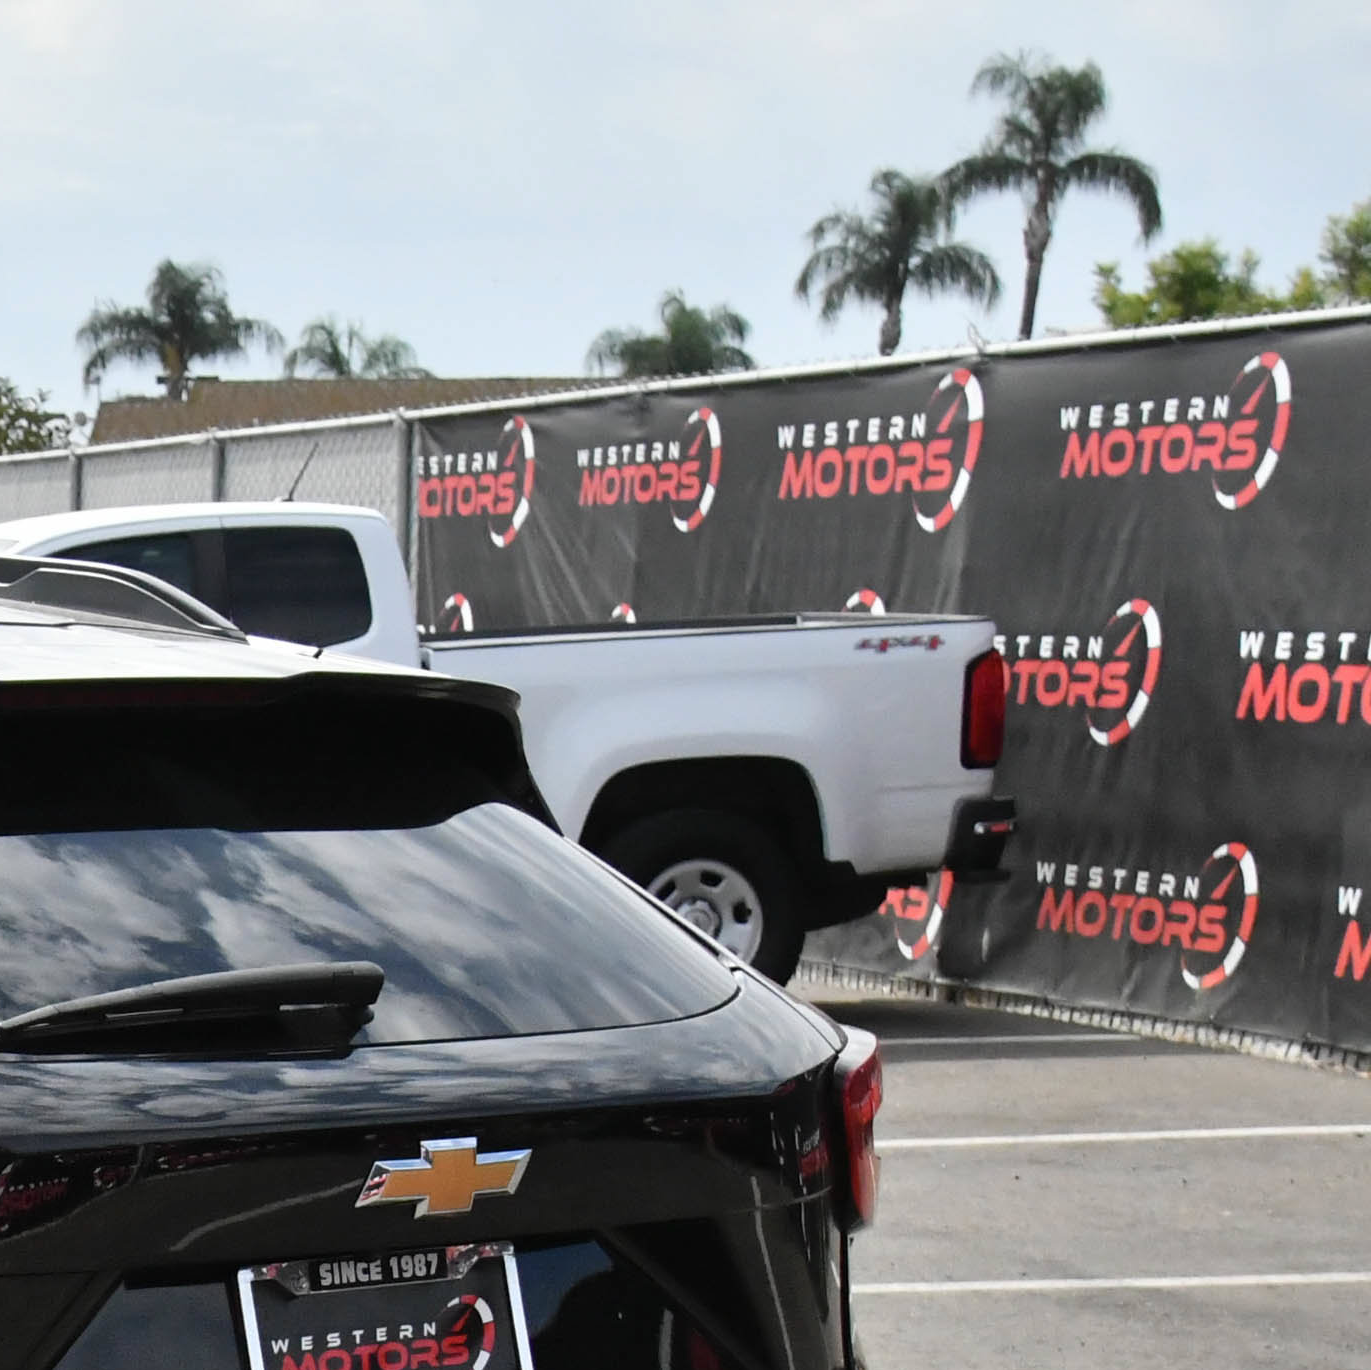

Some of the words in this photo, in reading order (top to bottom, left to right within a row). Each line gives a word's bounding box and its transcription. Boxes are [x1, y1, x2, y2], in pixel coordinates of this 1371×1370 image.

[1060, 395, 1229, 430] WESTERN
[778, 413, 927, 449] WESTERN
[1060, 418, 1258, 479] MOTORS
[418, 450, 498, 475] ESTERN
[577, 440, 681, 467] WESTERN
[778, 438, 953, 499] MOTORS
[418, 471, 516, 518] OTORS
[579, 460, 701, 506] MOTORS
[993, 635, 1104, 659] STERN
[1239, 630, 1371, 661] WEST
[1003, 659, 1131, 709] TORS
[1036, 861, 1200, 899] WESTERN
[1036, 887, 1227, 953] MOTORS
[319, 1257, 382, 1287] SINCE
[389, 1252, 439, 1279] 1987
[271, 1321, 437, 1355] WESTERN
